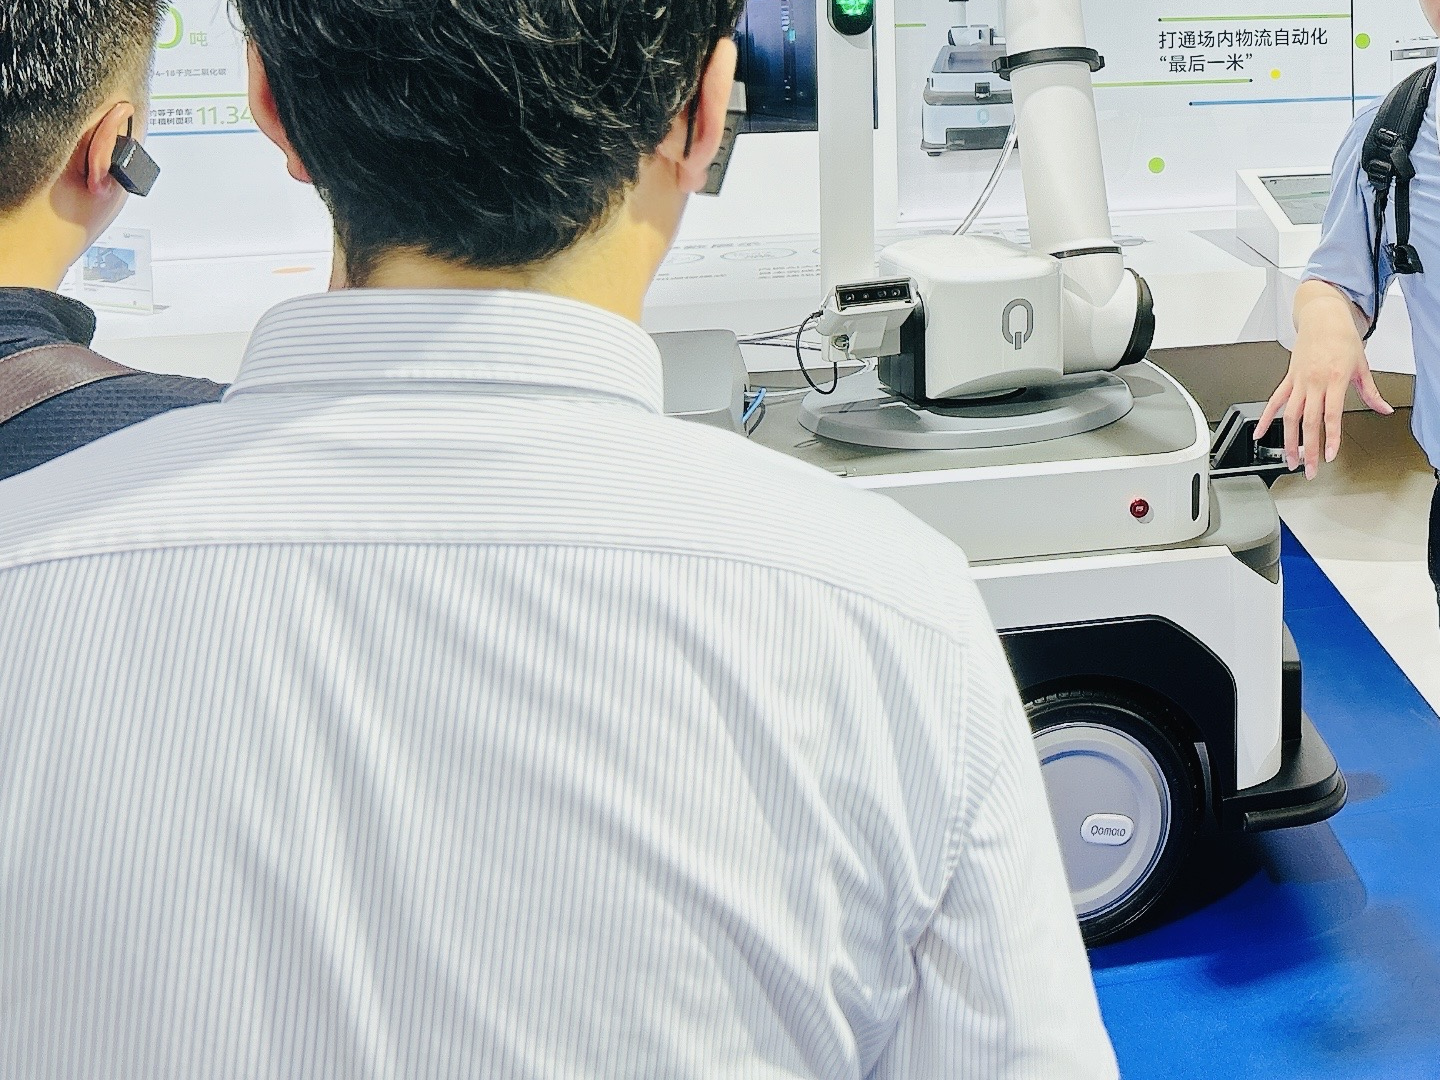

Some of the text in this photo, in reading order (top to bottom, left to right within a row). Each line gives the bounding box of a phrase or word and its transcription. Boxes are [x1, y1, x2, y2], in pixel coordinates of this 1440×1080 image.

[1158, 27, 1328, 49] 打通场内物流自动化
[1159, 52, 1253, 73] “最后一米”
